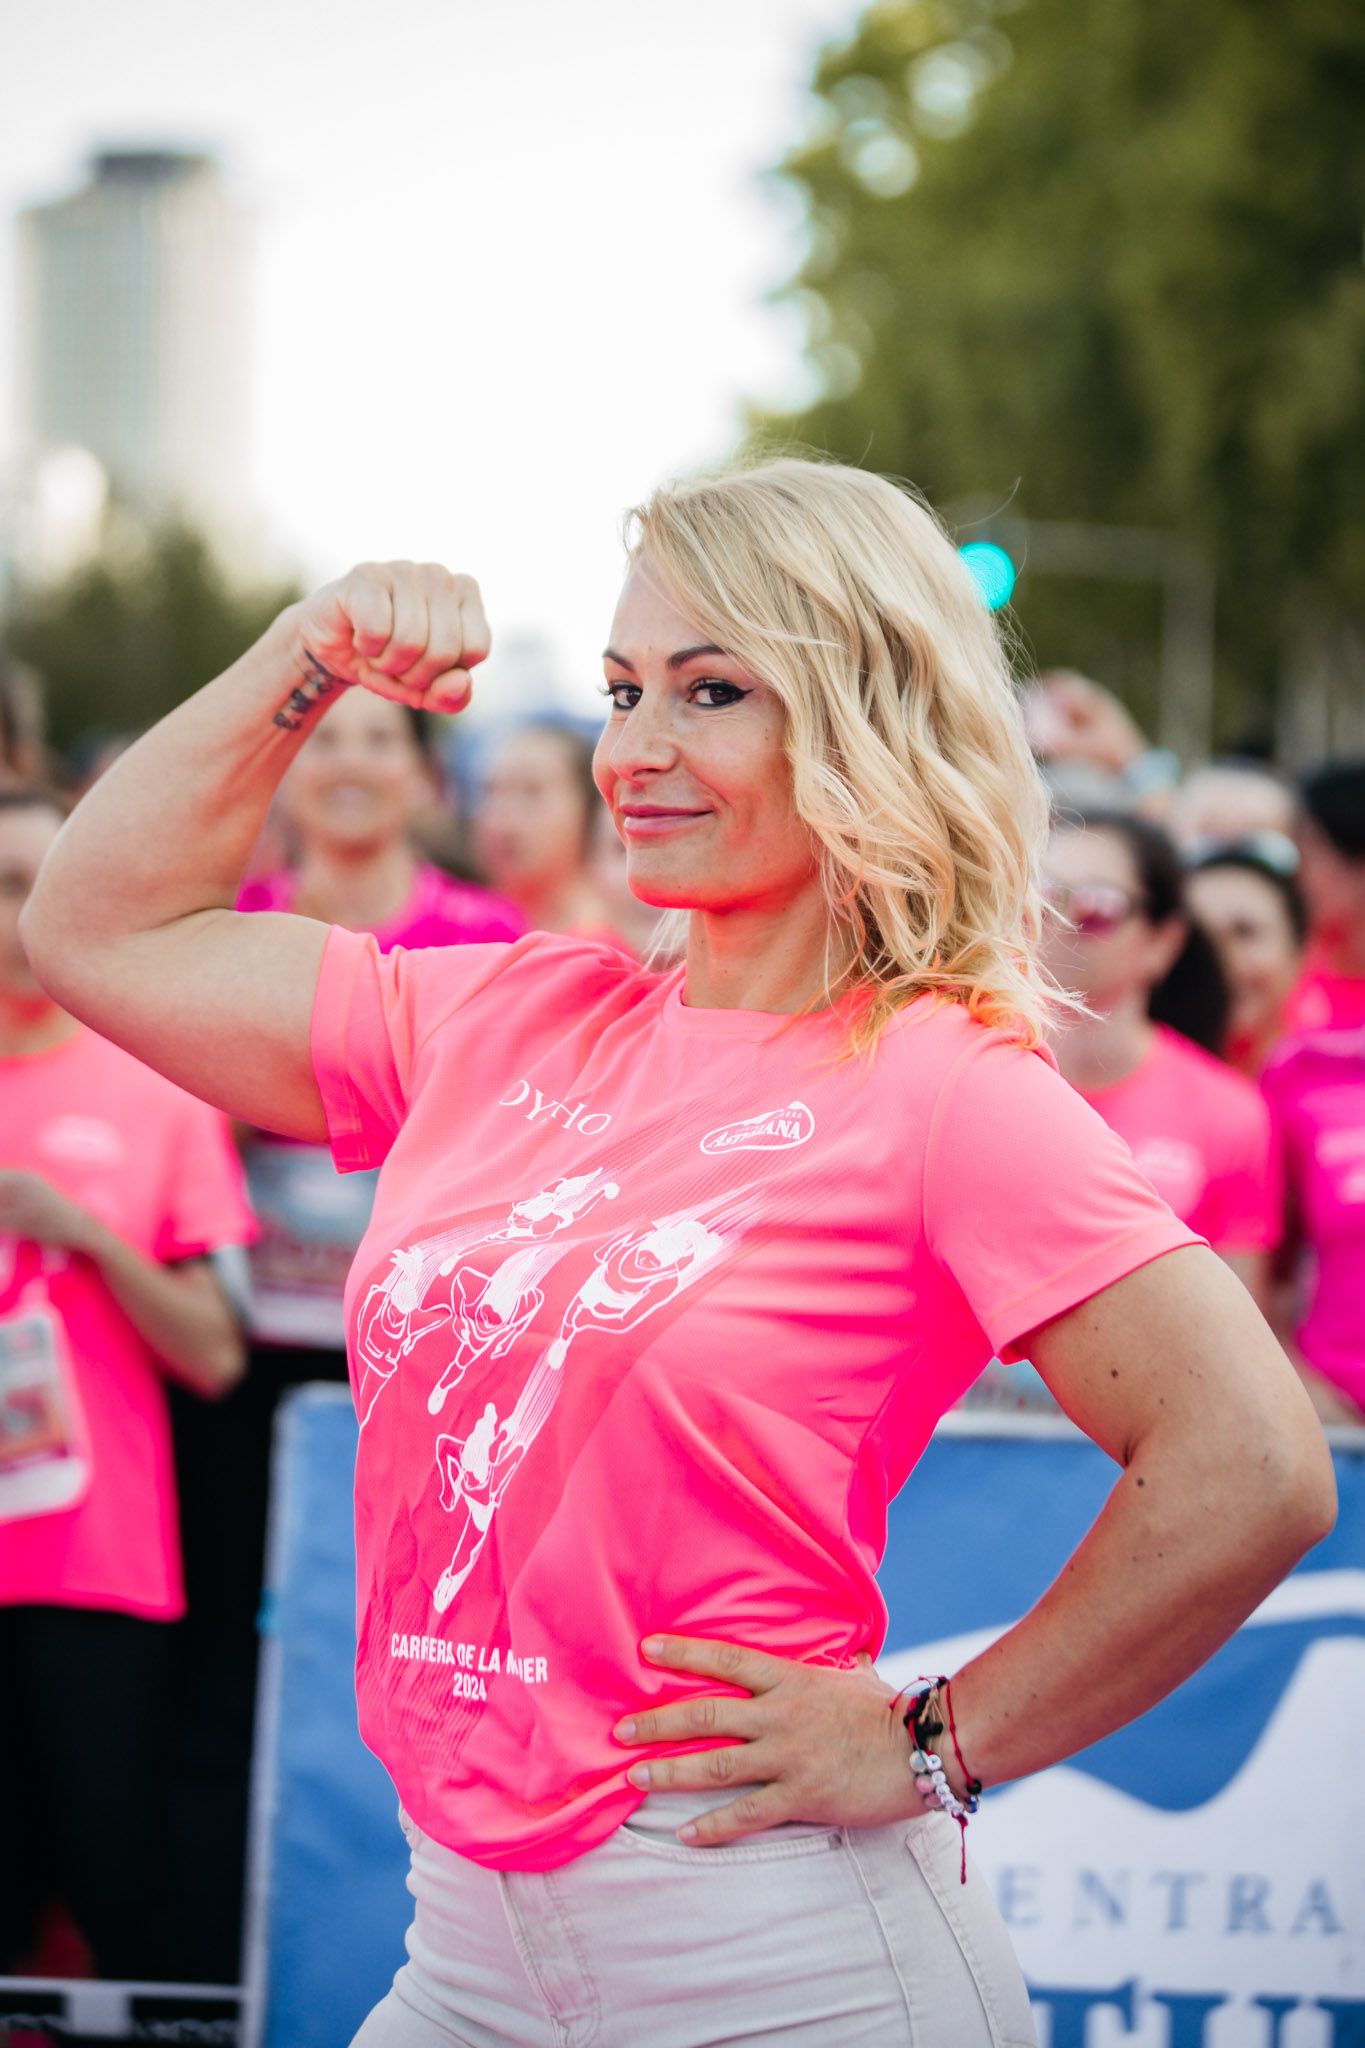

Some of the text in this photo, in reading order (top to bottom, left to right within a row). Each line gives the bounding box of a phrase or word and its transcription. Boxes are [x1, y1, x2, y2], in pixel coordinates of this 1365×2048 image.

[457, 1643, 475, 1669] DE
[478, 1647, 500, 1673] LA
[453, 1672, 487, 1700] 2024
[998, 1865, 1345, 1934] ENTRA
